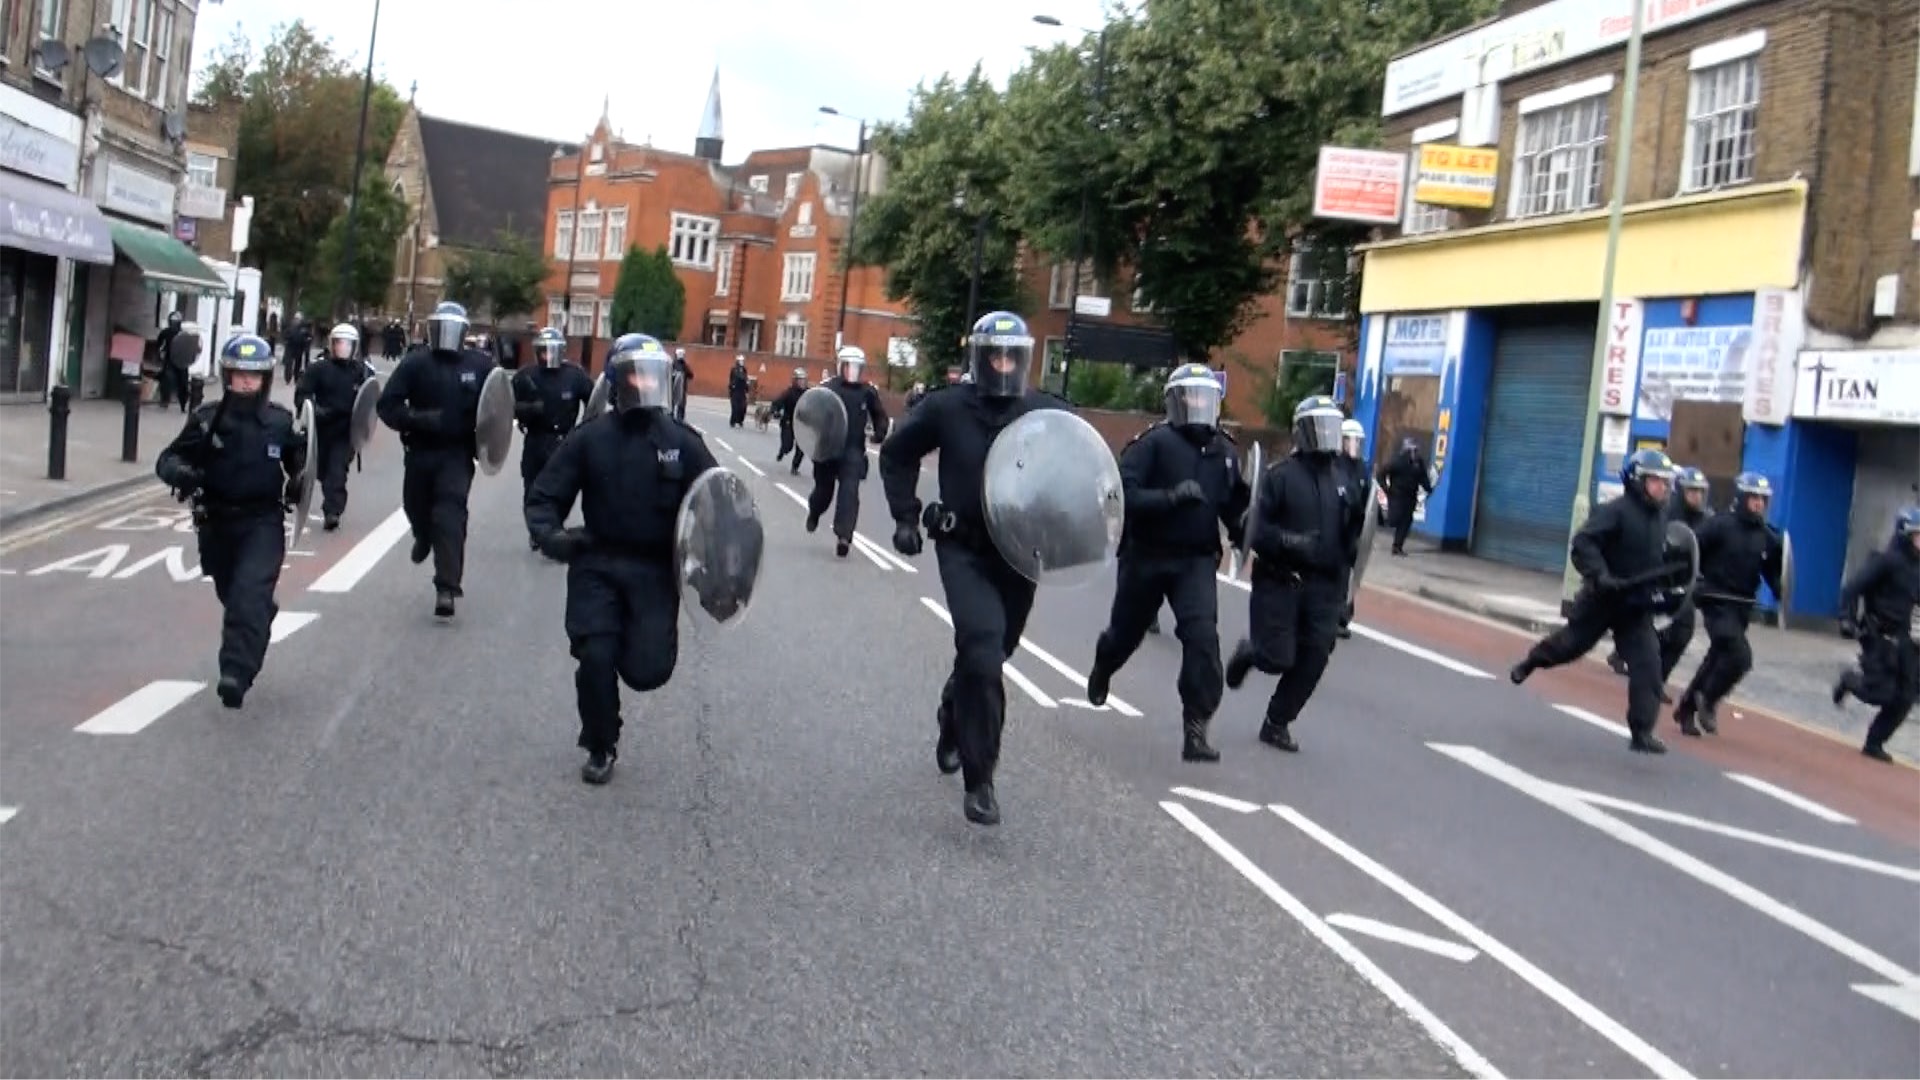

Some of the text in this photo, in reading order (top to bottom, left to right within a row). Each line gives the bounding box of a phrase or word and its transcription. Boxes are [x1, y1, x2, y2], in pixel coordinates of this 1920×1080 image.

[1424, 150, 1495, 169] TO LET
[1394, 319, 1429, 340] MOT
[1604, 302, 1633, 407] TYRES
[1753, 294, 1785, 417] BRAKES
[1803, 353, 1879, 417] TITAN
